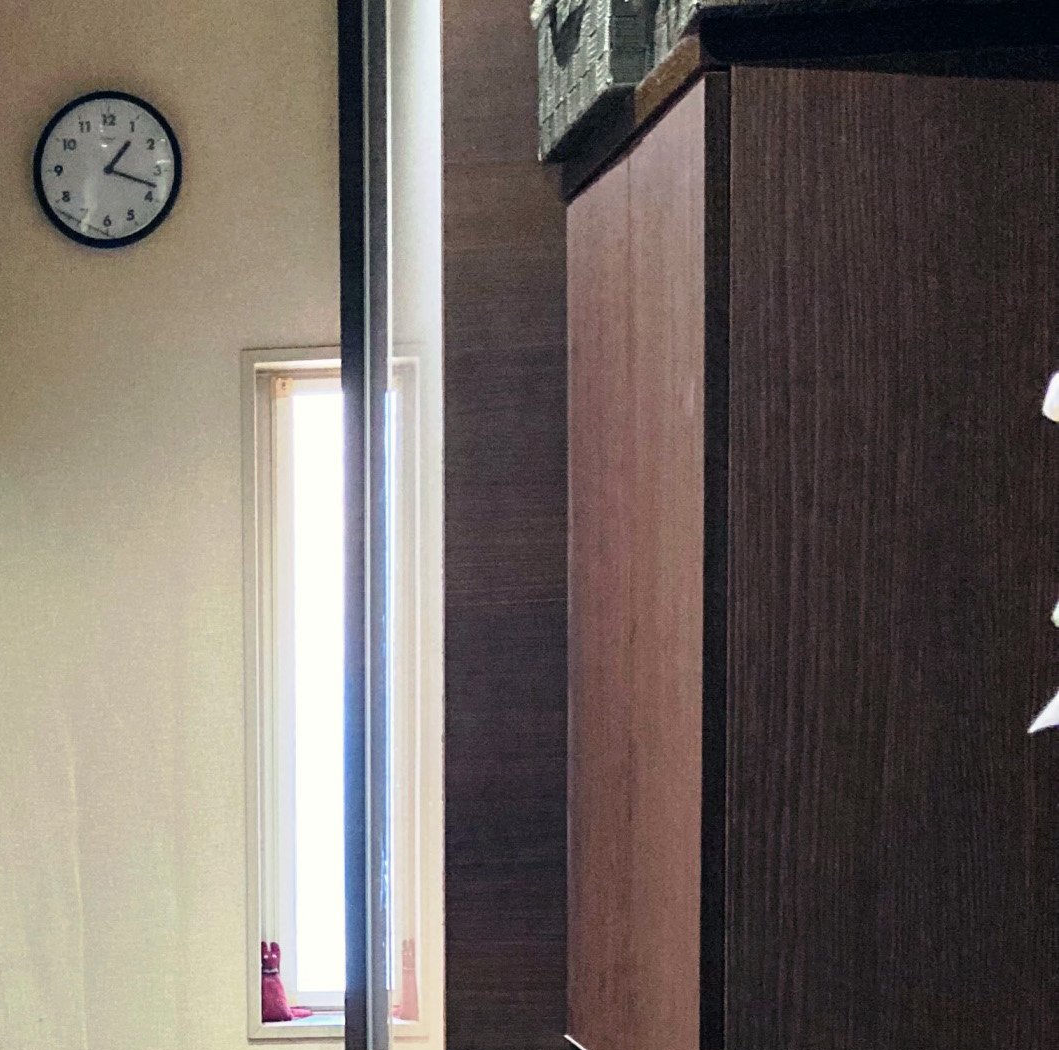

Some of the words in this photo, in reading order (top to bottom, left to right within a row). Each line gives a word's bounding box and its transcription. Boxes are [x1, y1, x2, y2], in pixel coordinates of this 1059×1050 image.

[102, 114, 116, 126] 12
[79, 121, 91, 133] 11
[129, 121, 135, 132] 1
[62, 138, 77, 150] 10
[146, 138, 155, 150] 2
[54, 165, 63, 176] 9
[153, 165, 162, 176] 3
[62, 191, 71, 202] 8
[144, 191, 154, 202] 4
[103, 215, 112, 227] 6
[126, 209, 135, 221] 5
